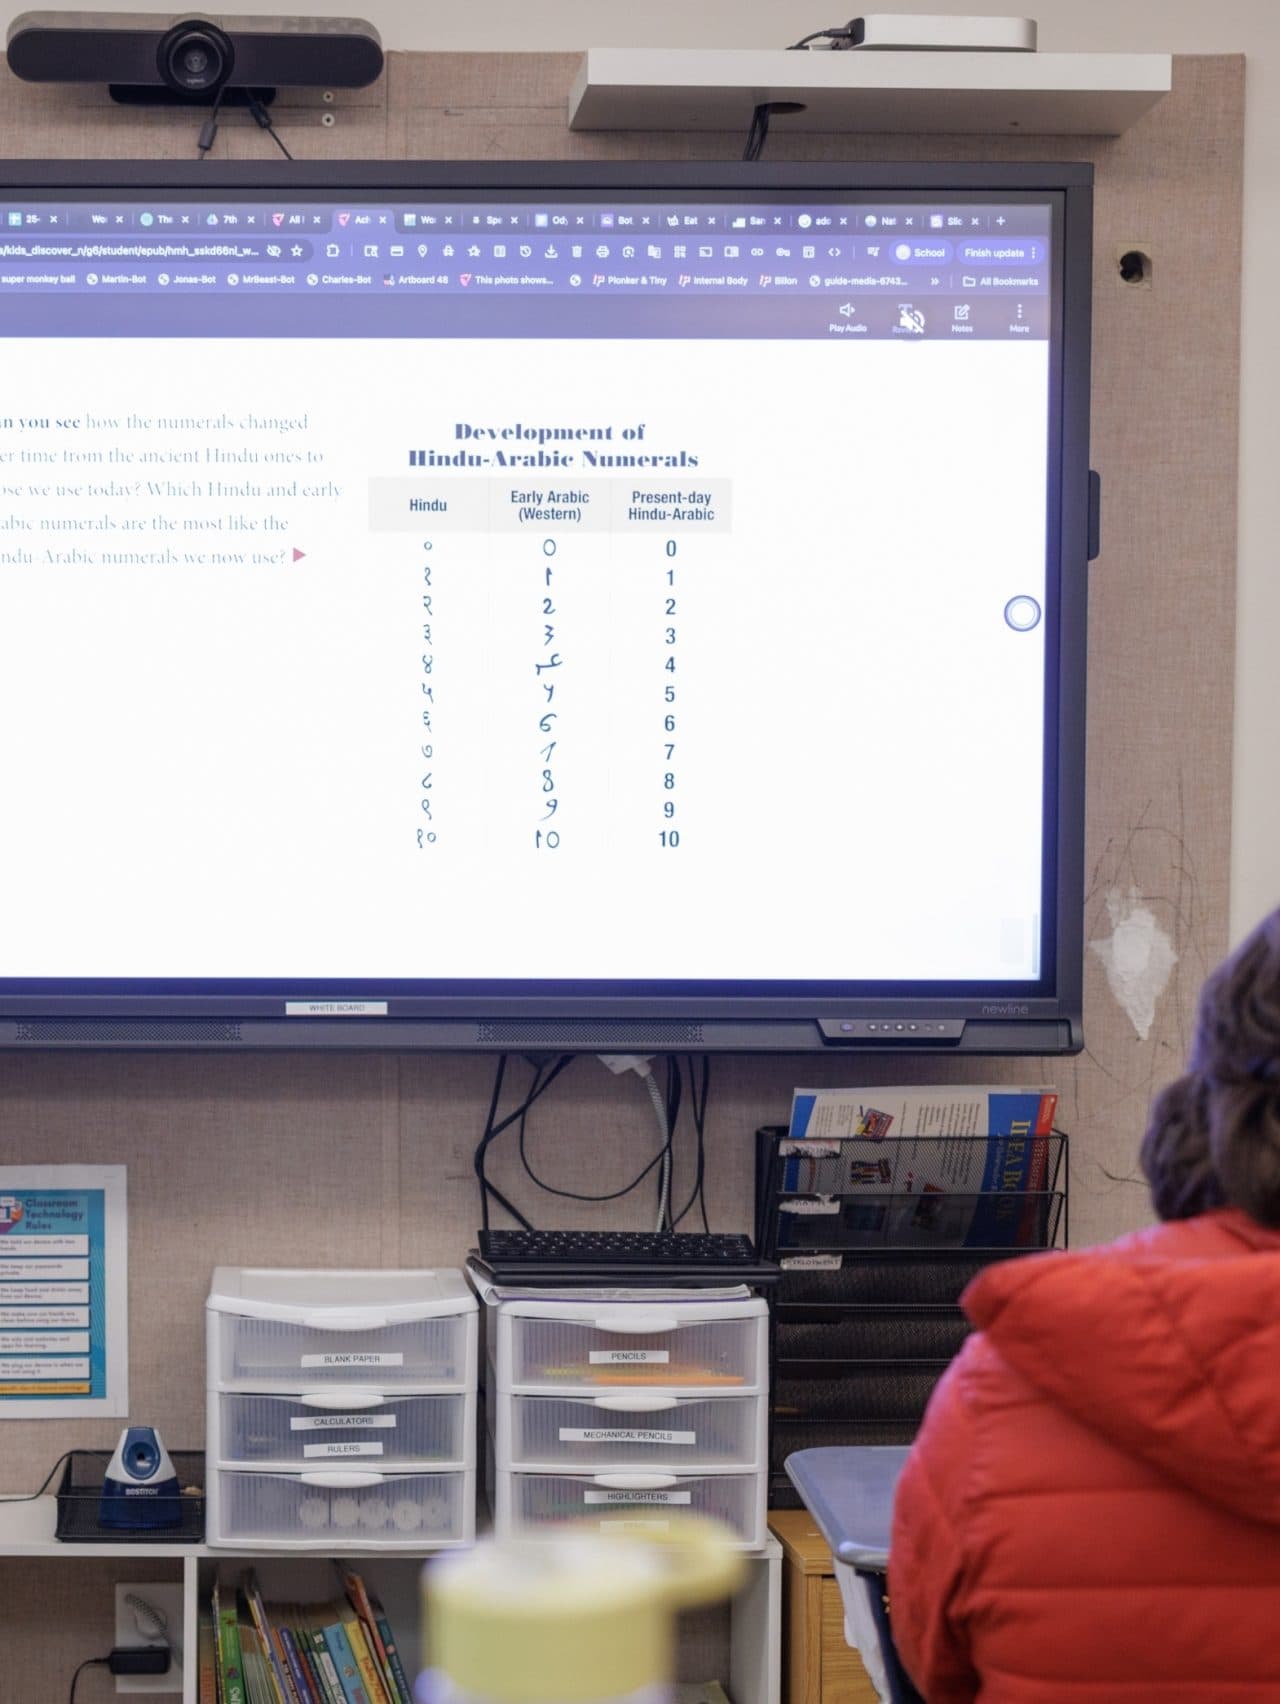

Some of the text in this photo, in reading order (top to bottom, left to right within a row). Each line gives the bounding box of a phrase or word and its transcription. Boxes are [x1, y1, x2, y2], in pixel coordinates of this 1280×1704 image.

[223, 215, 238, 224] 7th
[914, 248, 946, 258] School
[964, 248, 1025, 260] Finish update
[1, 274, 76, 286] super monkey ball
[102, 274, 146, 284] Martin-Bot
[173, 274, 216, 284] Jonas-Bot
[322, 274, 372, 284] Charles-Bot
[399, 275, 435, 284] Artboard
[475, 275, 492, 286] This
[494, 275, 518, 286] photo
[649, 275, 668, 286] Tiny
[693, 275, 748, 287] Internal Body
[980, 276, 1039, 286] All Bookmarks
[829, 324, 868, 334] Play Audio
[951, 324, 974, 334] Notes
[18, 419, 51, 433] you
[55, 419, 81, 429] see
[86, 414, 120, 429] how
[126, 414, 152, 429] the
[157, 414, 235, 429] numerals
[239, 414, 308, 433] changed
[454, 423, 646, 444] Development of
[20, 448, 57, 464] time
[62, 448, 104, 464] from
[109, 448, 134, 464] the
[139, 448, 200, 464] ancient
[206, 448, 259, 464] Hindu
[264, 453, 302, 464] ones
[307, 448, 324, 464] to
[408, 450, 699, 468] Hindu-Arabic Numerals
[28, 487, 51, 497] we
[55, 487, 83, 497] use
[88, 482, 141, 501] today?
[147, 482, 202, 497] Which
[208, 482, 261, 497] Hindu
[266, 482, 297, 497] and
[302, 482, 342, 501] early
[510, 490, 590, 506] Early Arabic
[631, 490, 712, 506] Present-day
[409, 499, 447, 512] Hindu
[518, 507, 582, 523] (Western)
[628, 507, 716, 521] Hindu-Arabic
[40, 515, 117, 531] numerals
[121, 520, 147, 531] are
[152, 515, 178, 531] the
[183, 515, 223, 531] most
[228, 515, 258, 531] like
[263, 515, 289, 531] the
[666, 540, 677, 557] 0
[102, 548, 178, 564] numerals
[183, 553, 208, 564] we
[211, 553, 245, 564] now
[252, 548, 287, 564] use?
[666, 569, 674, 586] 1
[665, 598, 677, 615] 2
[665, 627, 676, 645] 3
[664, 656, 676, 673] 4
[665, 686, 675, 703] 5
[665, 715, 675, 732] 6
[664, 744, 675, 760] 7
[542, 769, 554, 792] 8
[664, 773, 675, 790] 8
[664, 801, 675, 819] 9
[658, 831, 680, 848] 10
[309, 1004, 335, 1012] WHITE
[982, 1002, 1029, 1015] newline
[25, 1198, 78, 1208] Classroom
[25, 1209, 83, 1221] Technology
[25, 1221, 52, 1230] Rules
[324, 1355, 380, 1363] BLANK PAPER
[611, 1352, 647, 1361] PENCILS
[314, 1417, 374, 1426] CALCULATORS
[583, 1431, 673, 1441] MECHANICAL PENCILS
[327, 1445, 361, 1454] RULERS
[125, 1487, 159, 1496] BOSTITCH
[607, 1492, 669, 1501] HIGHLIGHTERS
